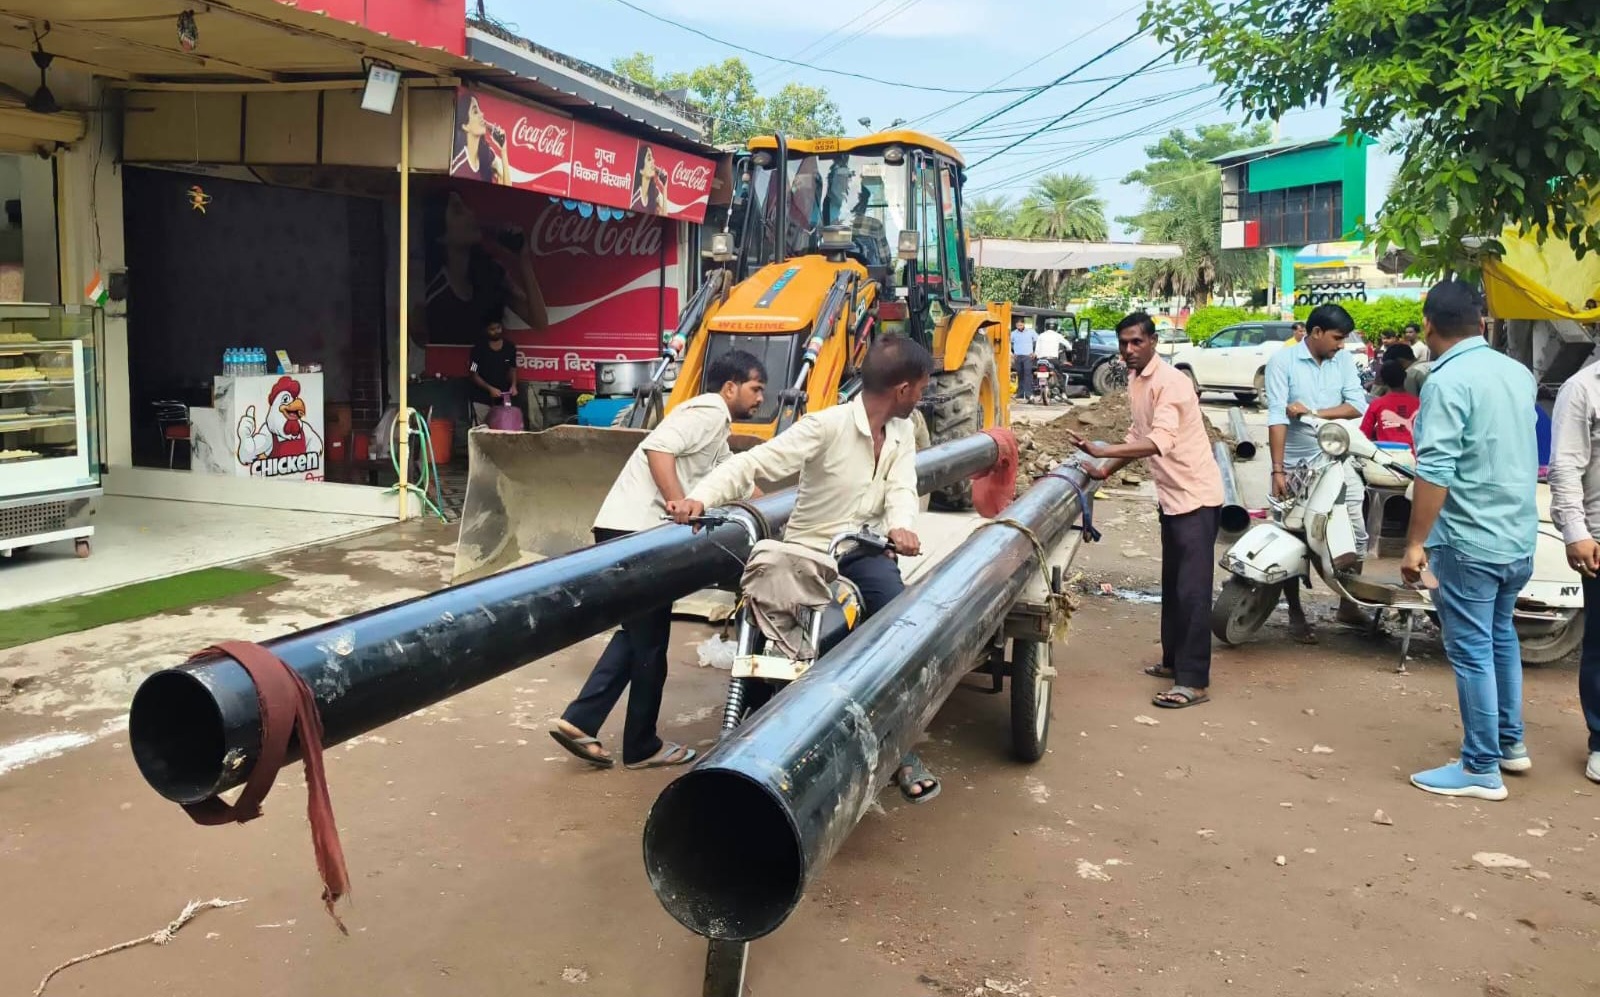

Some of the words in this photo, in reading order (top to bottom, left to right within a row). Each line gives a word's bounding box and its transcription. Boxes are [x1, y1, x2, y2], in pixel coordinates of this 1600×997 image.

[512, 117, 568, 157] Coca-Cola
[594, 148, 616, 168] गुप्ता
[573, 161, 599, 184] चिकन
[672, 161, 711, 191] Coca-Cola
[531, 203, 662, 256] CocaCola
[718, 321, 785, 330] WELCOME
[1560, 586, 1580, 596] NV
